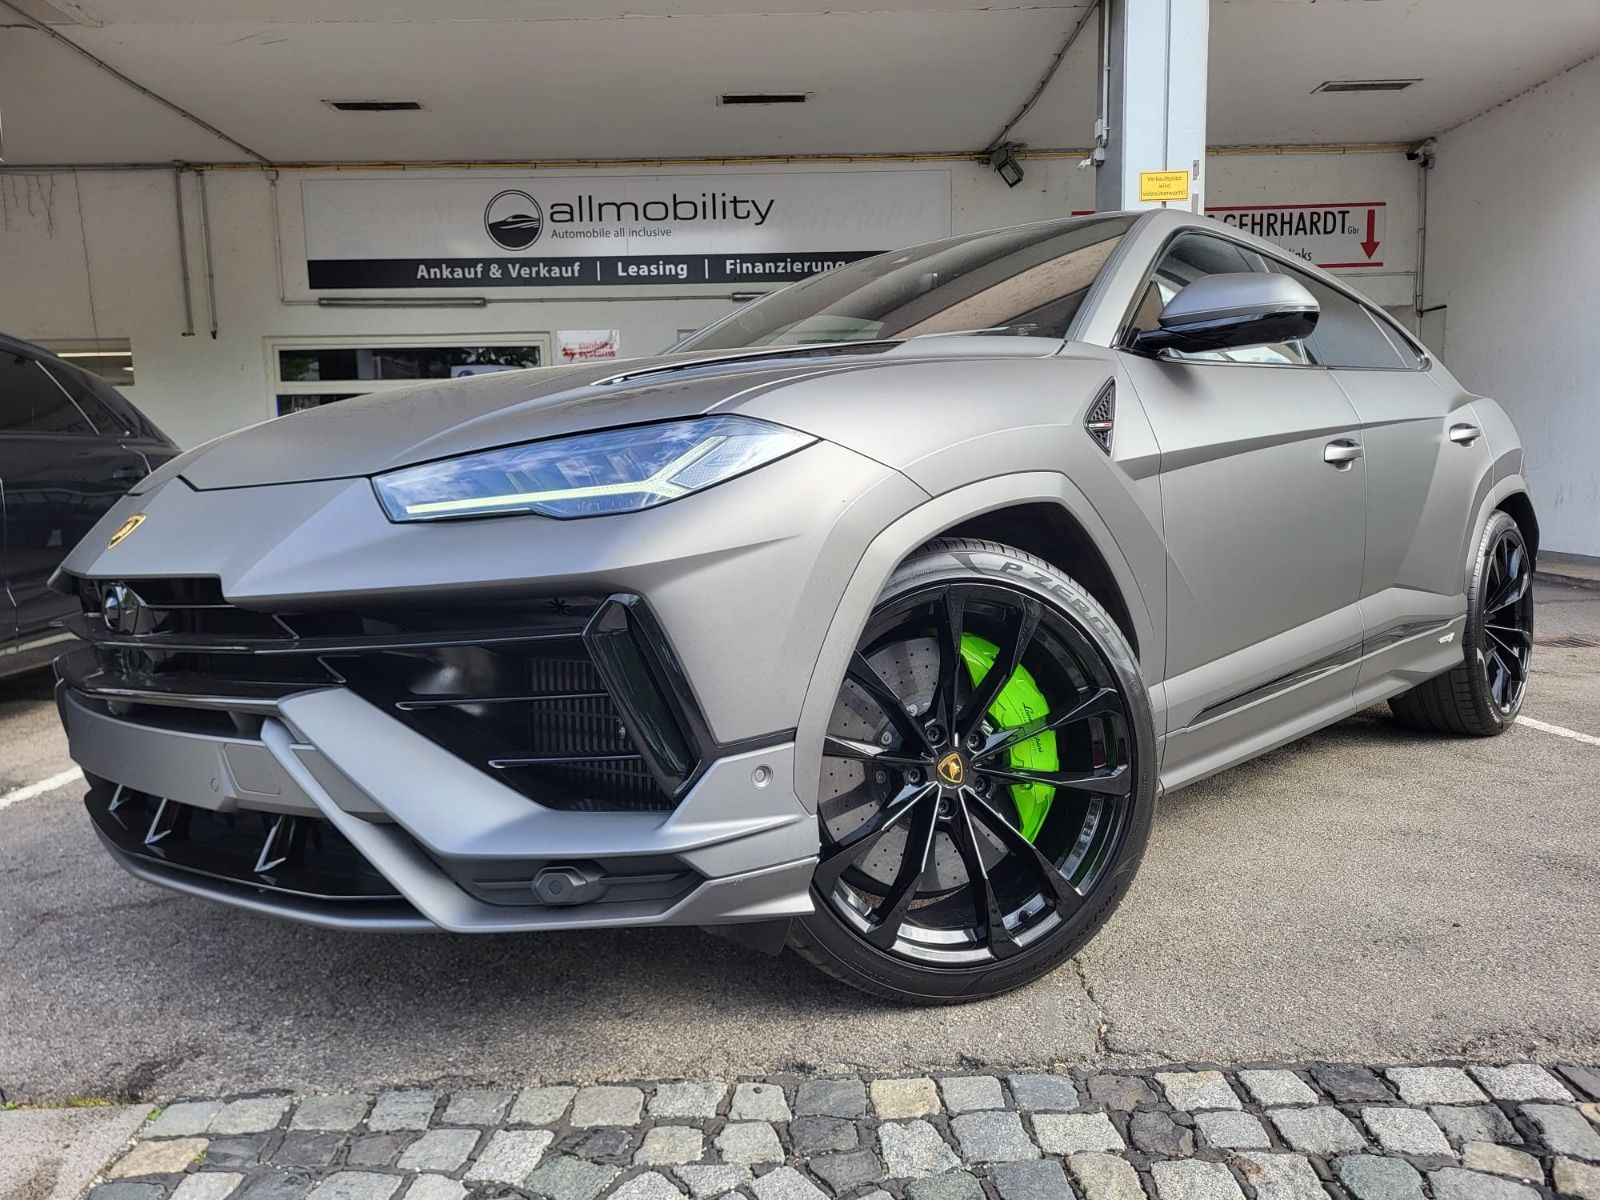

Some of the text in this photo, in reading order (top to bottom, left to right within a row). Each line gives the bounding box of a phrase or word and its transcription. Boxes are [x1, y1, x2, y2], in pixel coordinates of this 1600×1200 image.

[549, 192, 775, 226] allmobility
[551, 227, 672, 239] Automobile all inclusive
[416, 263, 484, 280] Ankauf
[489, 263, 502, 279] &
[507, 262, 581, 279] Verkauf
[617, 260, 688, 279] Leasing
[1000, 561, 1111, 635] P ZERO
